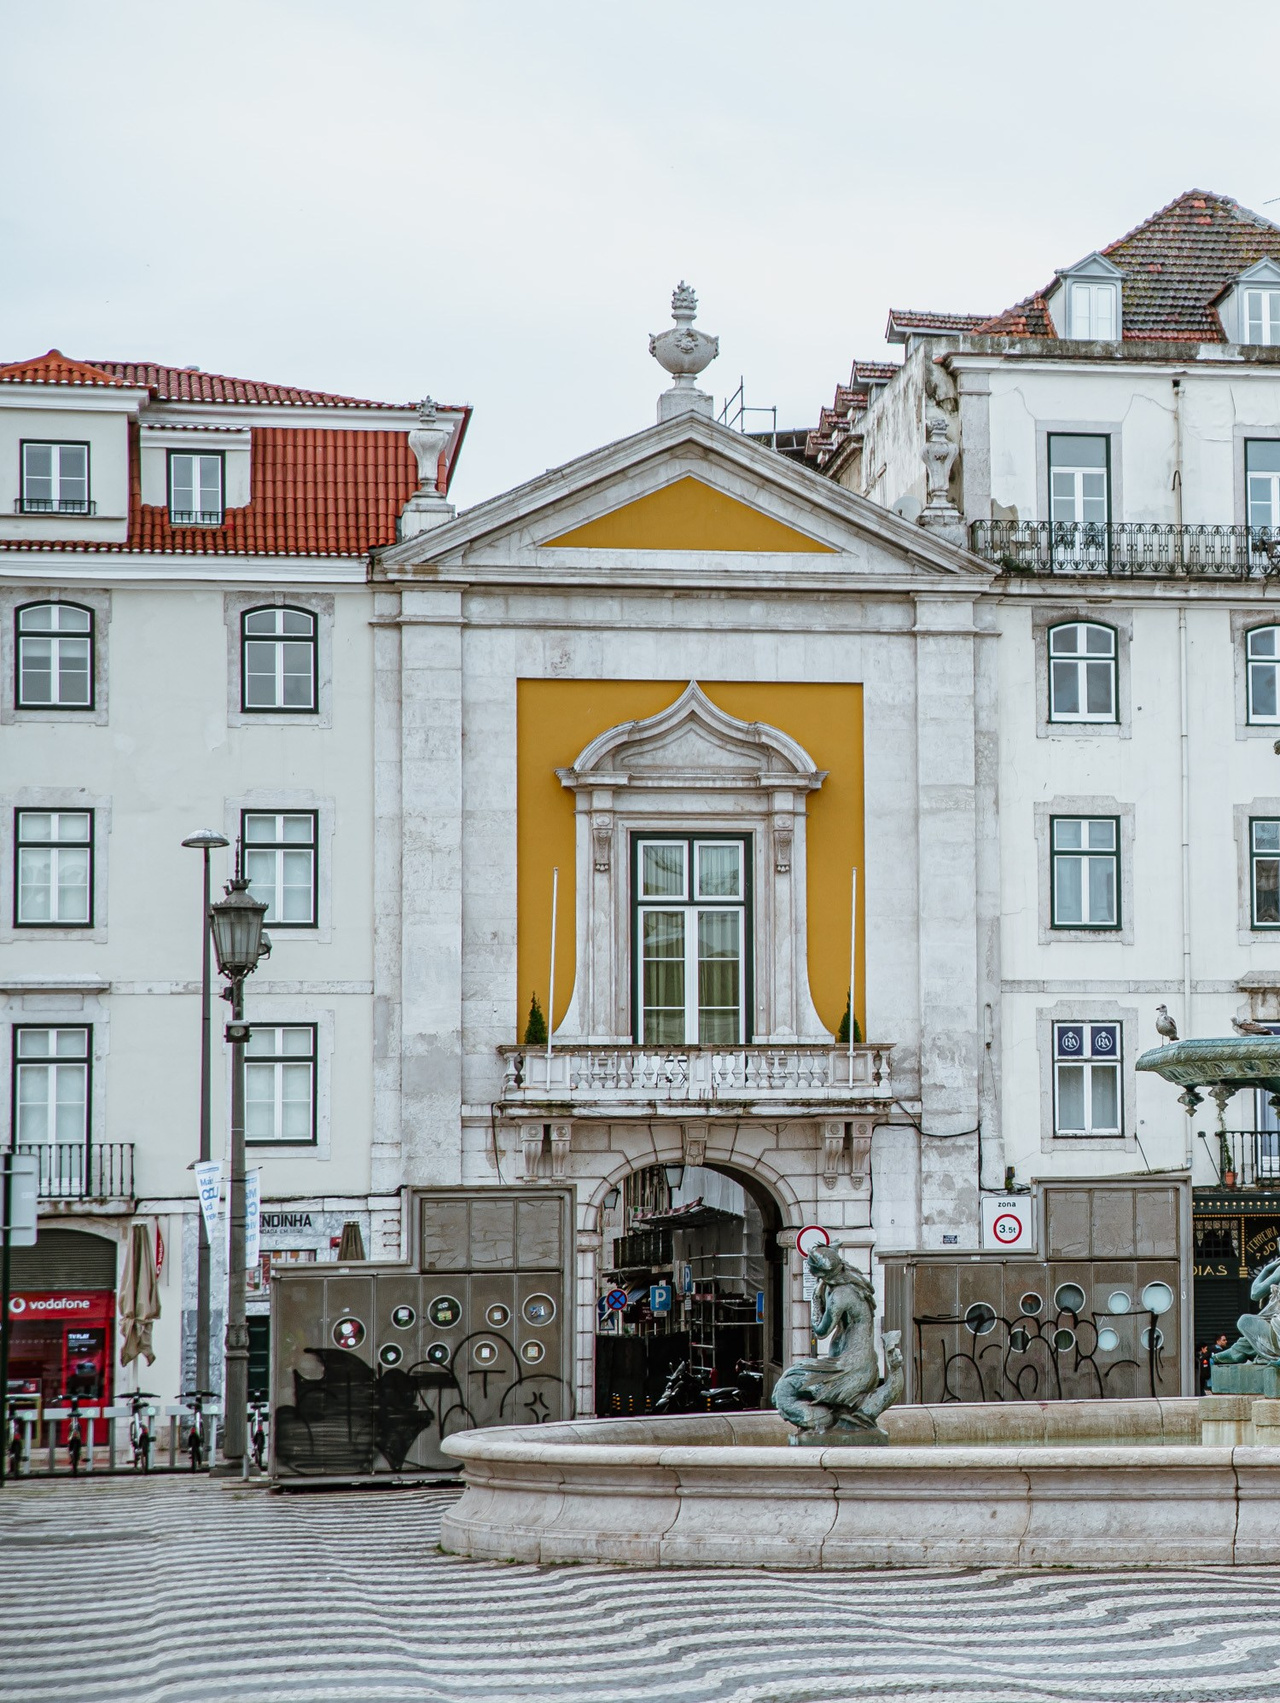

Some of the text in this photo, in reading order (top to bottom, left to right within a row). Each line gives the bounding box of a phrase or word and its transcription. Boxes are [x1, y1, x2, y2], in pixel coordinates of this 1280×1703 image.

[259, 1213, 312, 1228] NDINHA
[998, 1224, 1017, 1234] 3.5t
[1246, 1225, 1279, 1253] FERREIRA
[1263, 1241, 1277, 1256] JO
[29, 1298, 90, 1310] vodafone
[655, 1289, 667, 1308] P
